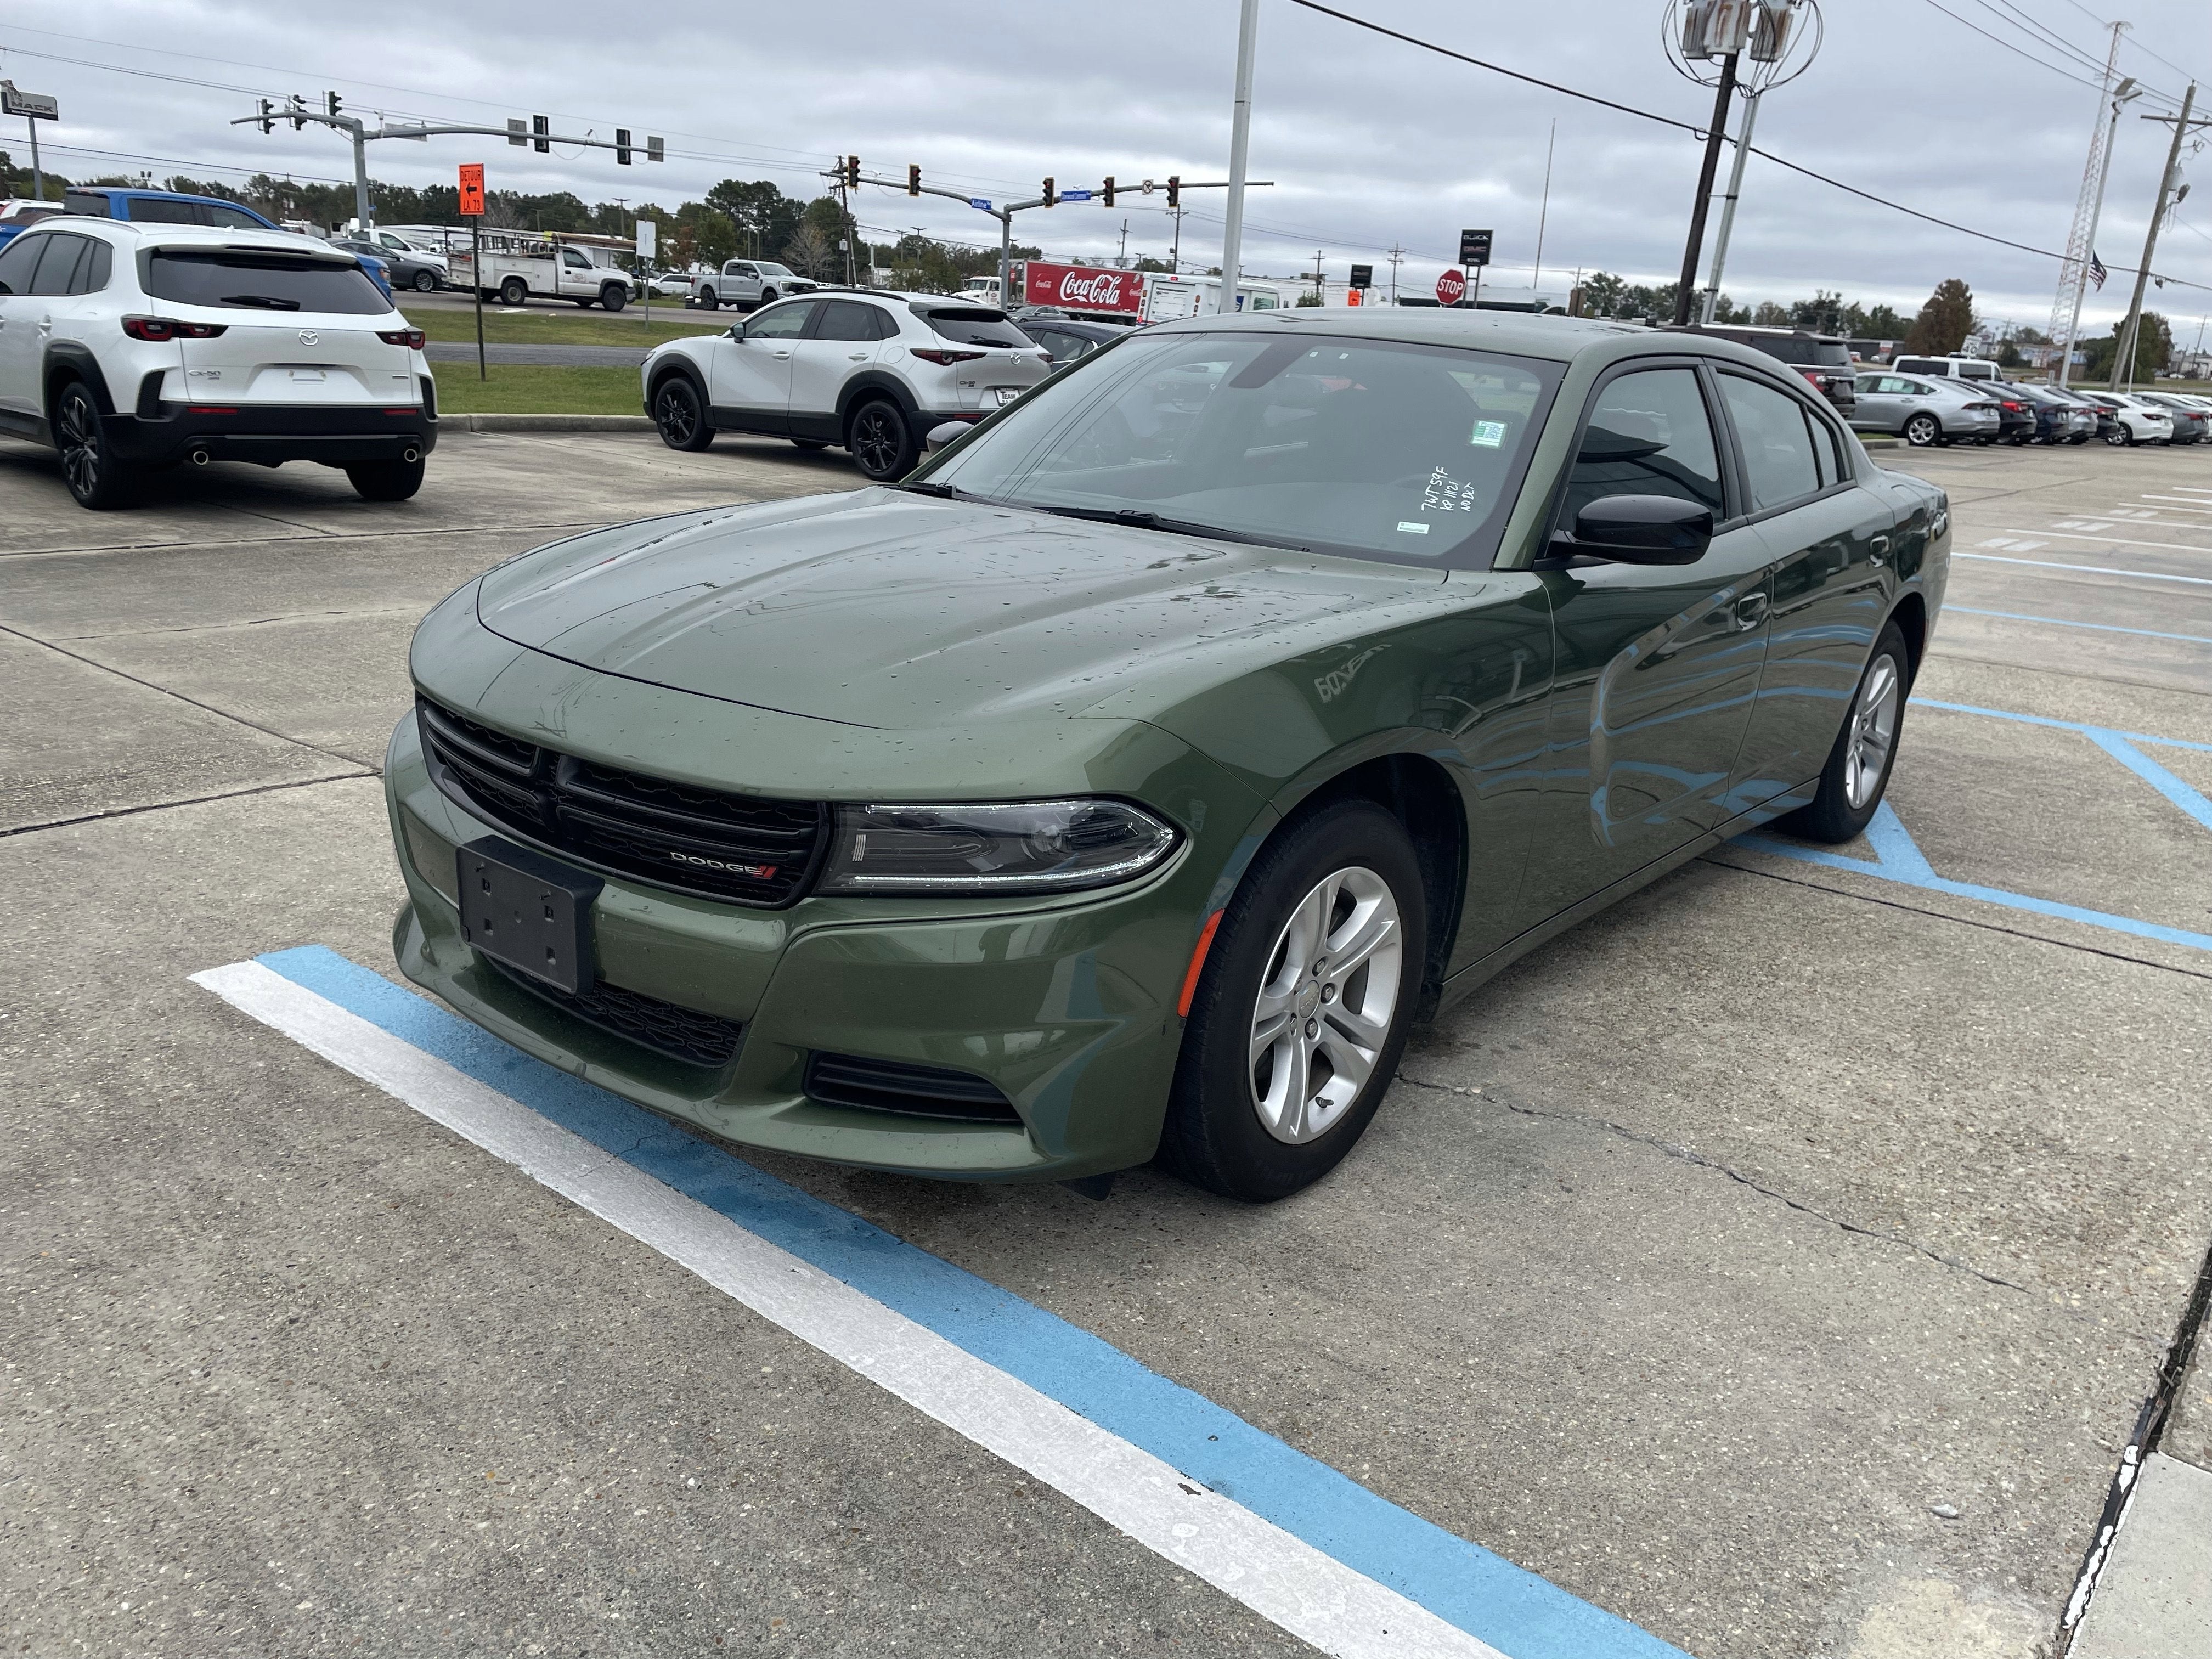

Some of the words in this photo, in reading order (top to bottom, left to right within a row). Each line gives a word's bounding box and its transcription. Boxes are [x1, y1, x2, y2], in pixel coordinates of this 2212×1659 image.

[11, 101, 53, 112] MACK
[461, 170, 481, 182] DETOUR
[464, 200, 470, 211] LA
[473, 199, 480, 211] 73
[1059, 271, 1123, 305] Coca-Cola
[1438, 278, 1464, 295] STOP
[670, 851, 763, 876] DODGE
